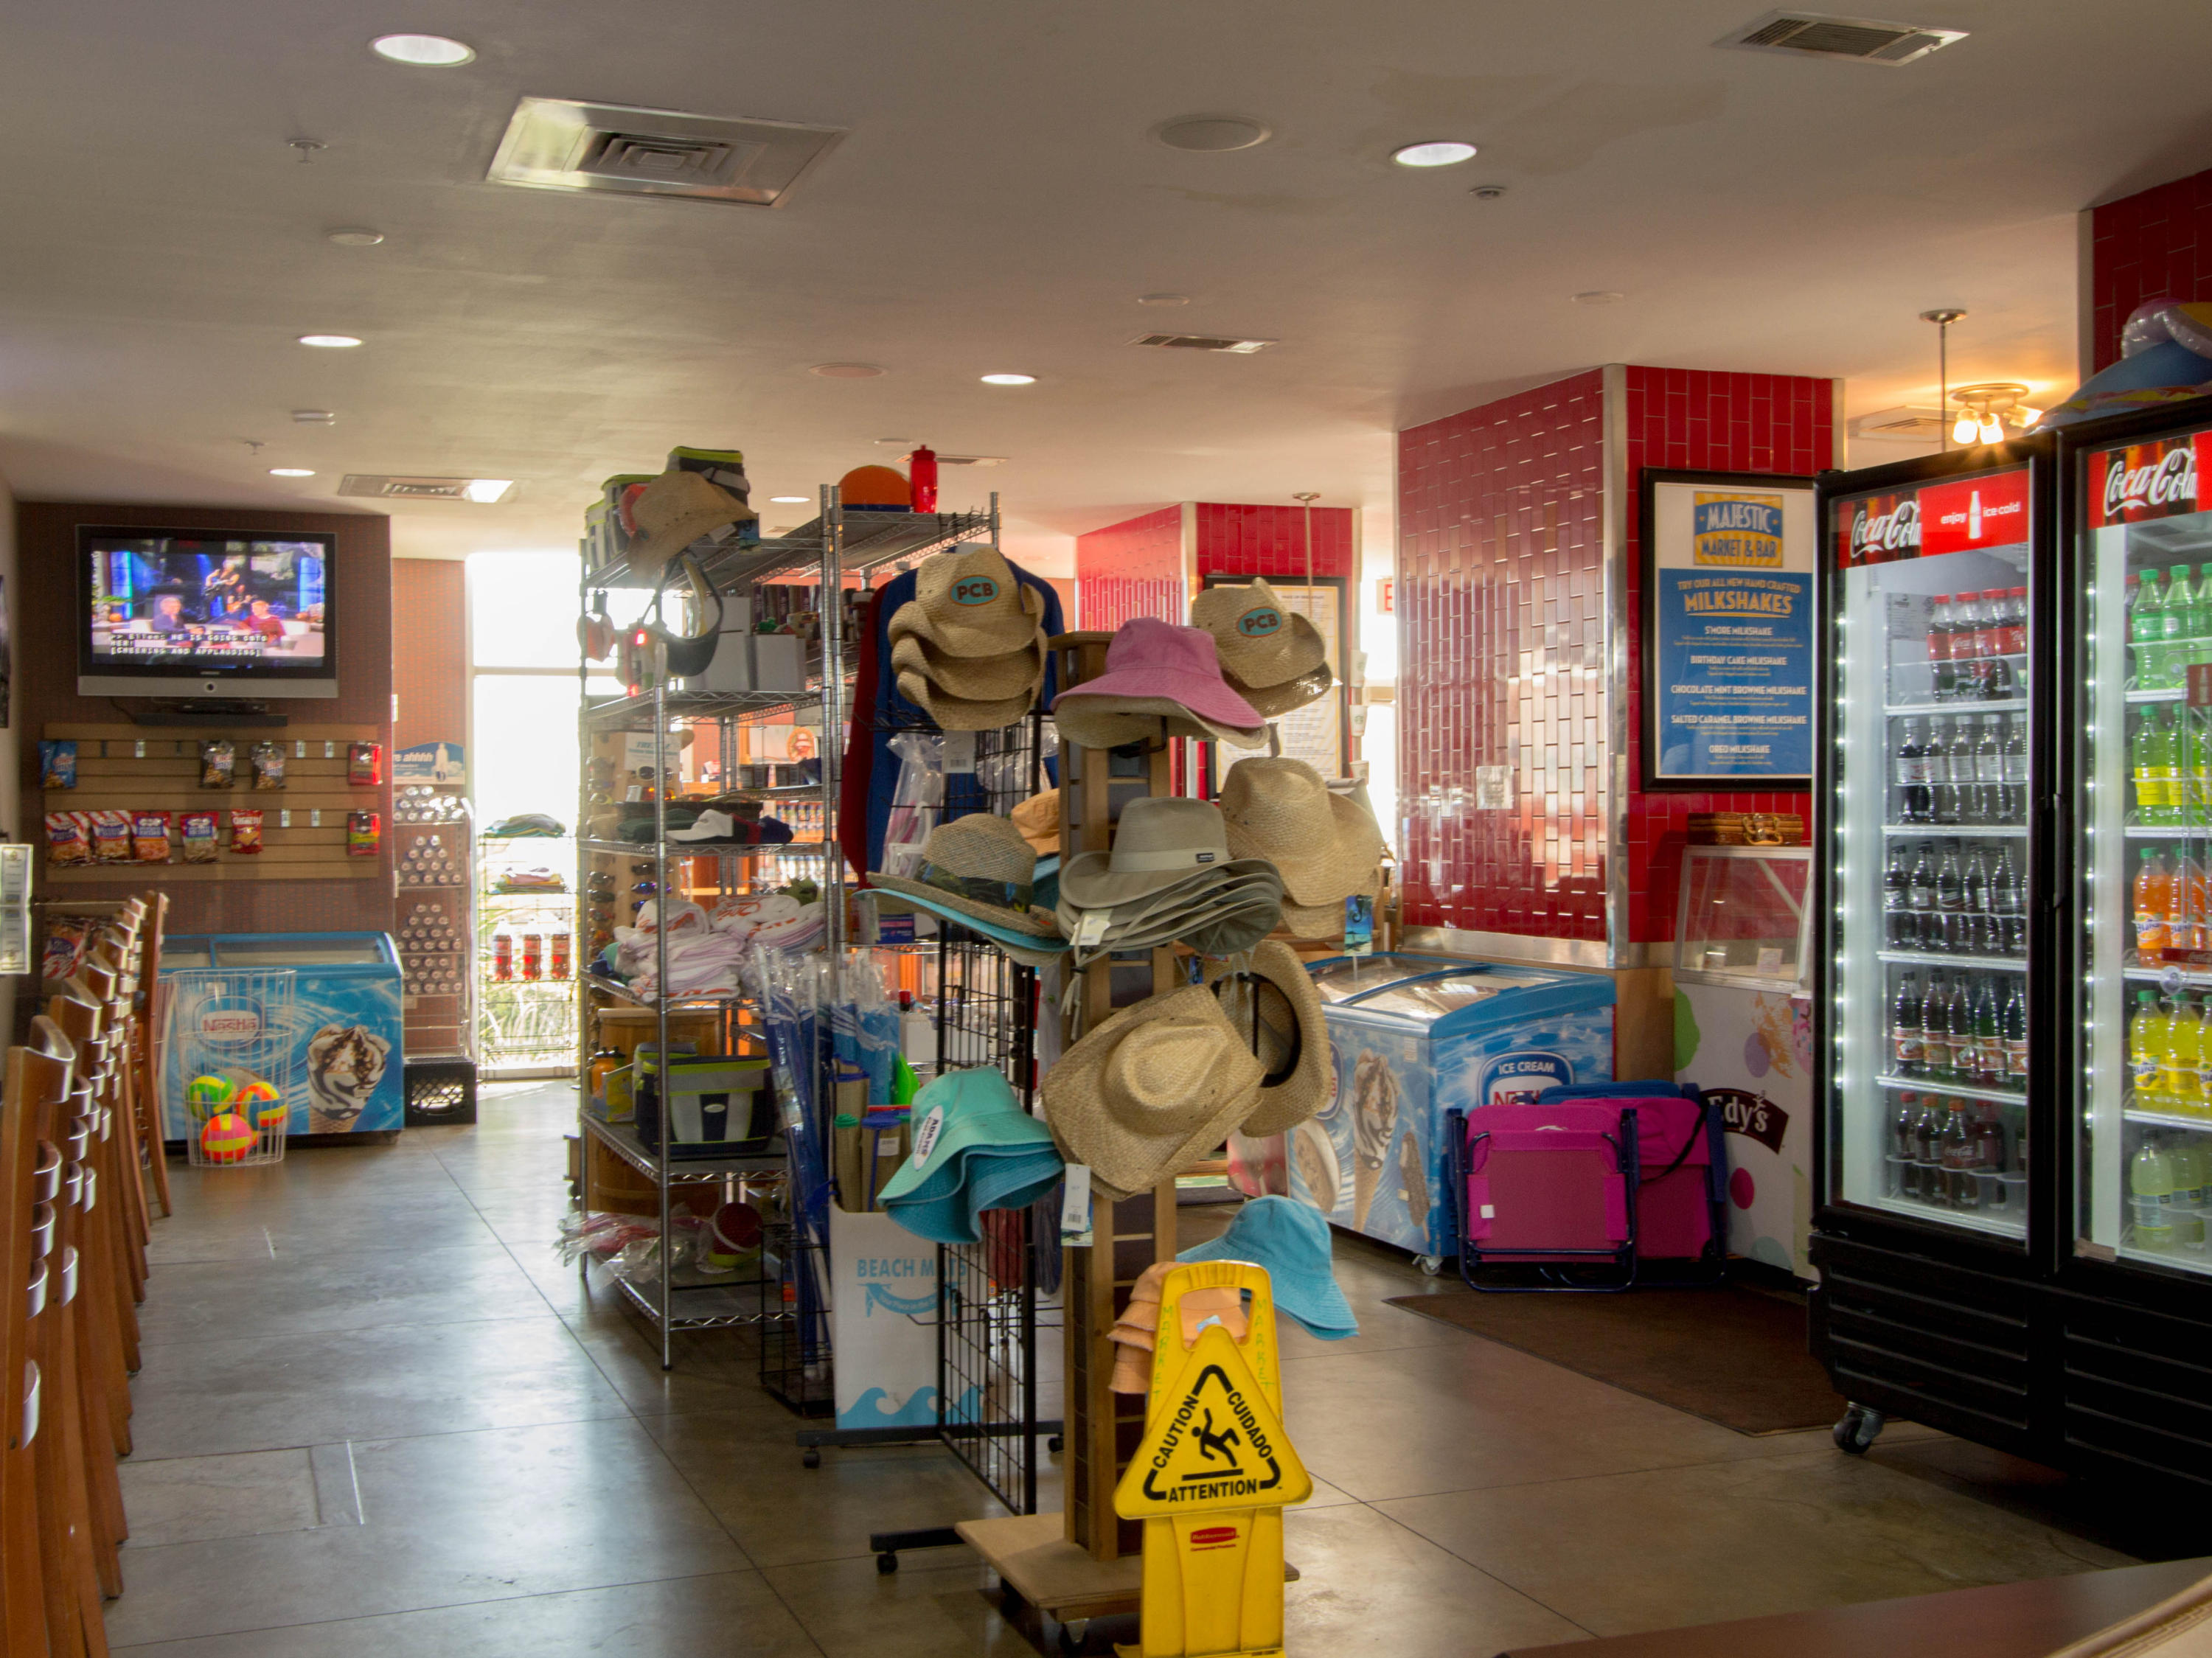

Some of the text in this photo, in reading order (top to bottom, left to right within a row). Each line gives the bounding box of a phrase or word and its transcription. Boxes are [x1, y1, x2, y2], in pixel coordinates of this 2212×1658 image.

[1706, 504, 1773, 533] MAJESTIC
[1941, 501, 2021, 525] enjoy ice cold
[1702, 539, 1778, 558] MARKET & BAR
[957, 582, 994, 601] PCB
[1711, 578, 1725, 588] ALL
[1727, 577, 1743, 587] NEW
[1767, 580, 1801, 593] CRAFTED
[1684, 591, 1793, 614] MILKSHAKES
[1243, 613, 1279, 633] PCB
[1733, 627, 1773, 636] MILKSHAKE
[1690, 655, 1788, 666] BIRTHDAY CAKE MILKSHAKE
[1671, 684, 1807, 695] CHOCOLATE MINT BROWNIE MILKSHAKE
[1671, 714, 1808, 725] SALTED CARAMEL BROWNIE MILKSHAKE
[1730, 745, 1771, 754] MILKSHAKE
[1498, 1061, 1556, 1075] ICE CREAM
[857, 1258, 967, 1278] BEACH MTS
[1152, 1395, 1200, 1469] CAUTION
[1227, 1391, 1273, 1459] CUIDADO
[1168, 1478, 1258, 1503] ATTENTION
